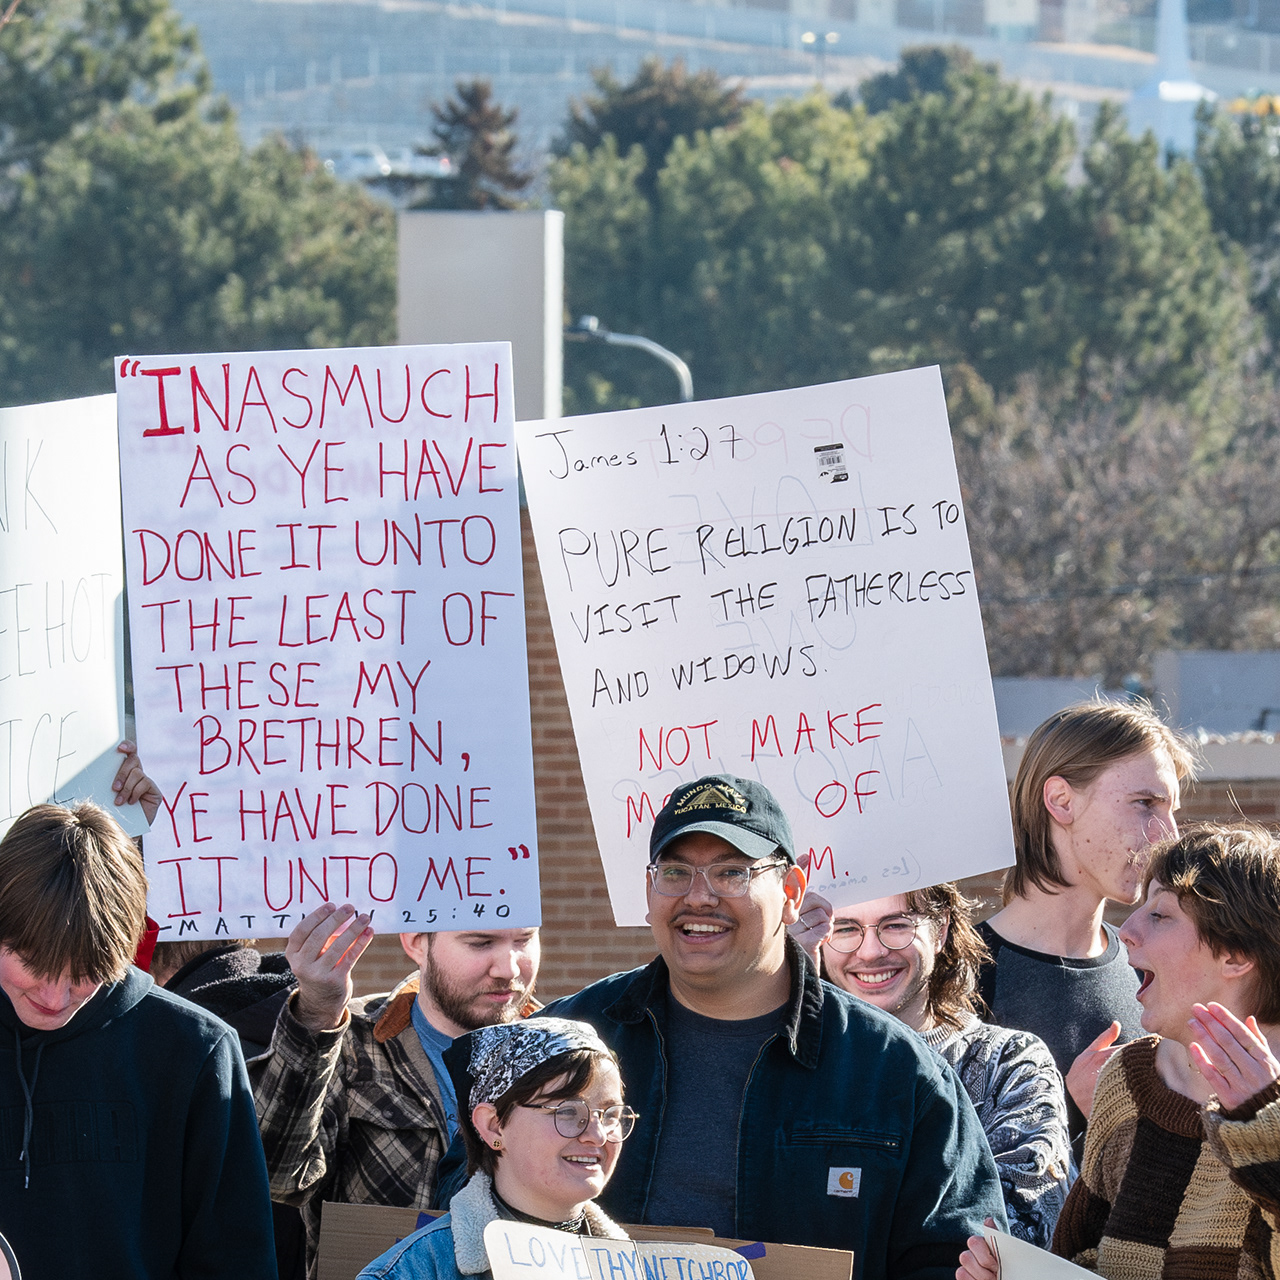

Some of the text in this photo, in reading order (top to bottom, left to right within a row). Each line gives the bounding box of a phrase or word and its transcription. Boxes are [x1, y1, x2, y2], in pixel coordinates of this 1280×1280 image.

[119, 359, 499, 437] "INASMUCH
[180, 437, 507, 509] AS YE HAVE
[535, 424, 743, 480] James 1:27
[132, 513, 496, 586] DONE IT UNTO
[558, 500, 960, 592] PURE RELIGION IS TO
[141, 590, 515, 652] THE LEAST OF
[570, 570, 972, 644] VISIT THE FATHERLESS
[155, 660, 431, 714] THESE MY
[592, 645, 829, 708] AND WIDOWS.
[193, 715, 471, 775] BRETHREN,
[638, 703, 884, 772] NOT MAKE
[162, 781, 493, 848] YE HAVE DONE
[676, 783, 713, 806] MUNDO
[715, 802, 747, 814] MEXICO
[717, 783, 746, 805] MAYA
[815, 770, 881, 818] OF
[157, 844, 531, 918] IT UNTO ME."
[402, 903, 512, 924] 25:40
[504, 1232, 591, 1280] LOVE
